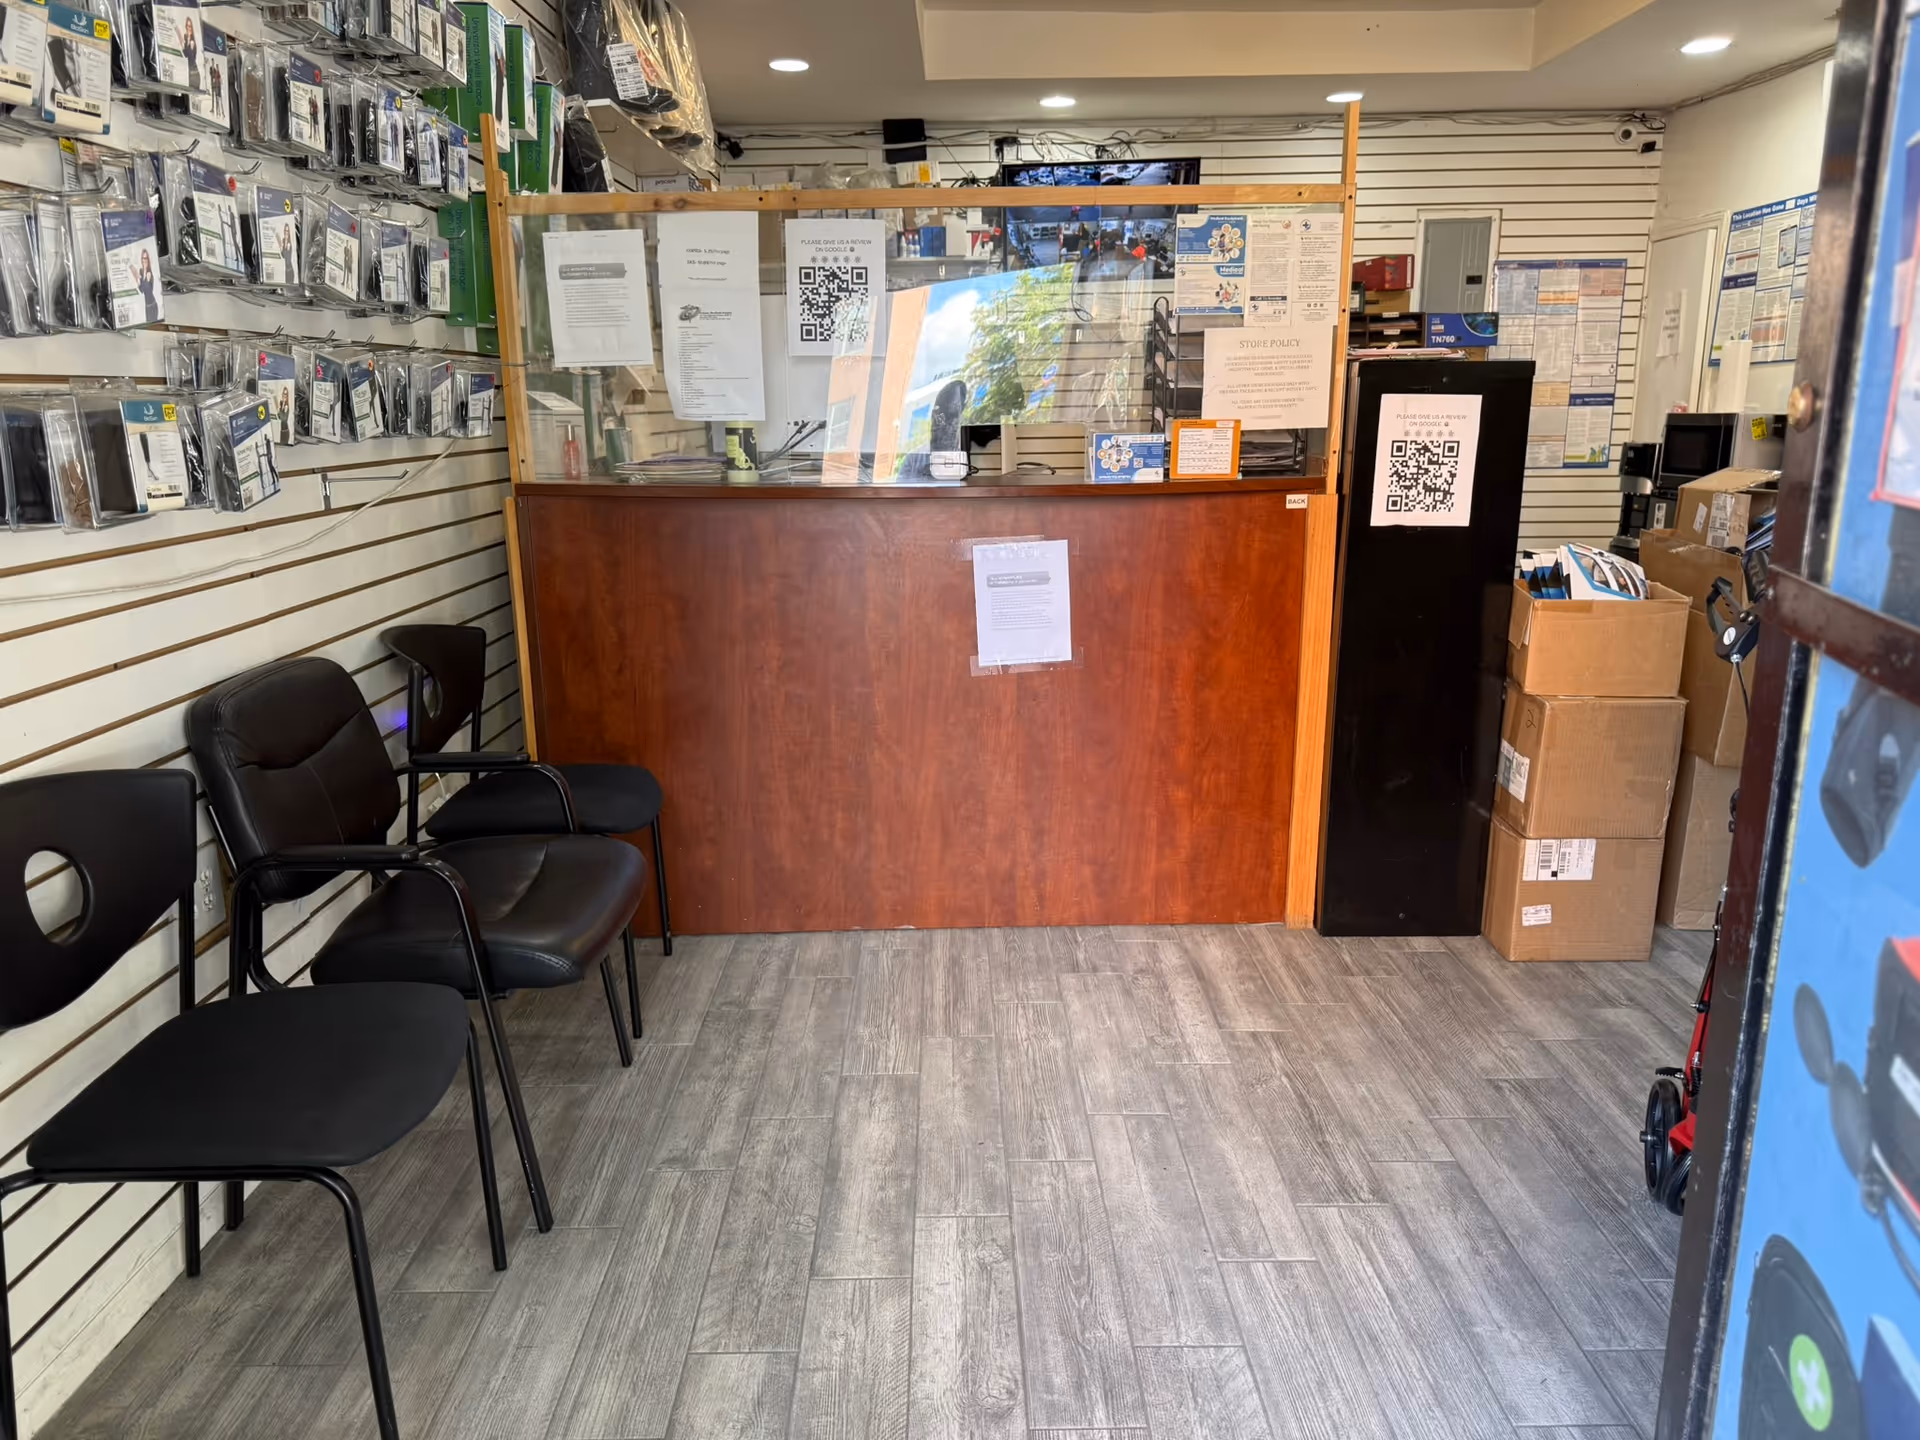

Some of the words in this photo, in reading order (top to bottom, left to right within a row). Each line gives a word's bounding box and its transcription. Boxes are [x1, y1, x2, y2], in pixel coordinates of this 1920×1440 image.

[1743, 209, 1762, 219] Location
[1239, 340, 1268, 349] STORE
[1270, 339, 1301, 348] POLICY
[1431, 335, 1455, 344] TN760
